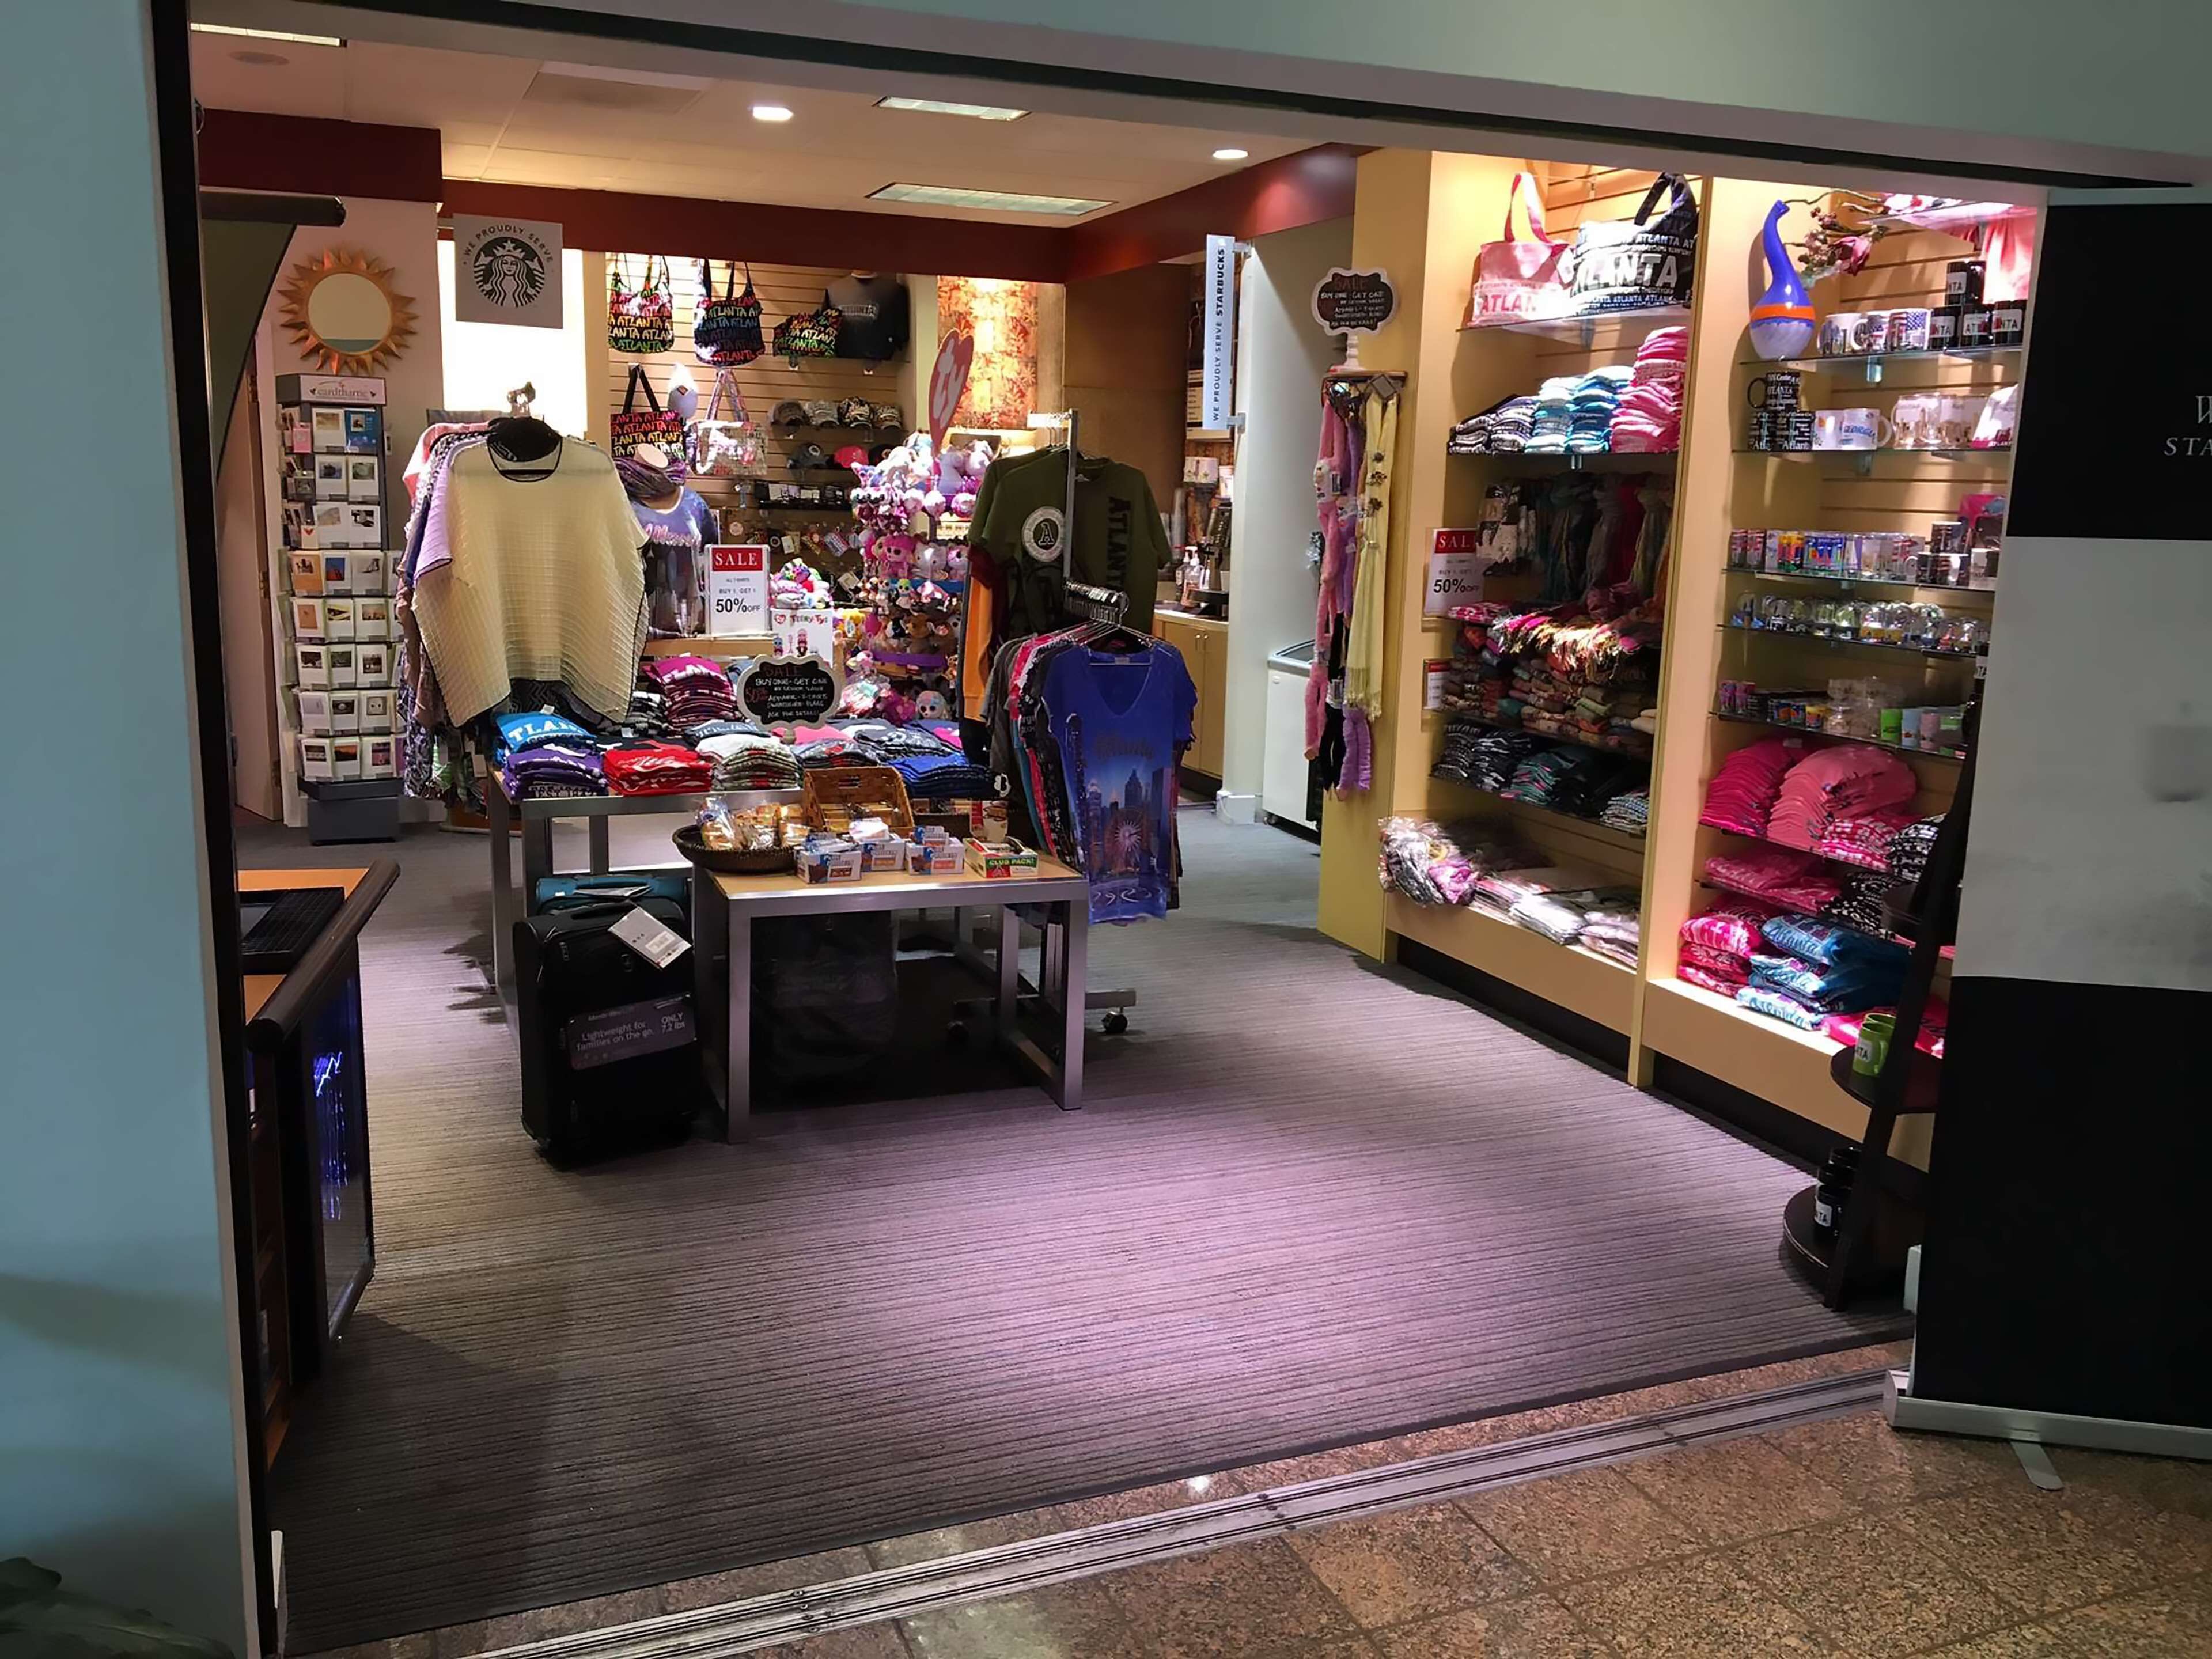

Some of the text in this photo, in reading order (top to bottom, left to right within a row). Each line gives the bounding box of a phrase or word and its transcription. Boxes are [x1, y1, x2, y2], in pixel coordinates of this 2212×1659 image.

[464, 224, 554, 263] WE PROUDLY SERVE
[1215, 248, 1225, 317] STARBUCKS
[618, 315, 663, 329] ATLANTA
[1213, 406, 1220, 421] WE
[1438, 535, 1471, 548] SAL
[715, 552, 757, 566] SALE
[1433, 578, 1466, 593] 50%
[715, 597, 761, 613] 50% OFF
[765, 665, 802, 677] SALE
[661, 1012, 684, 1024] ONLY
[582, 1021, 646, 1041] Lightweight for
[577, 1038, 611, 1051] families
[626, 1032, 641, 1040] the
